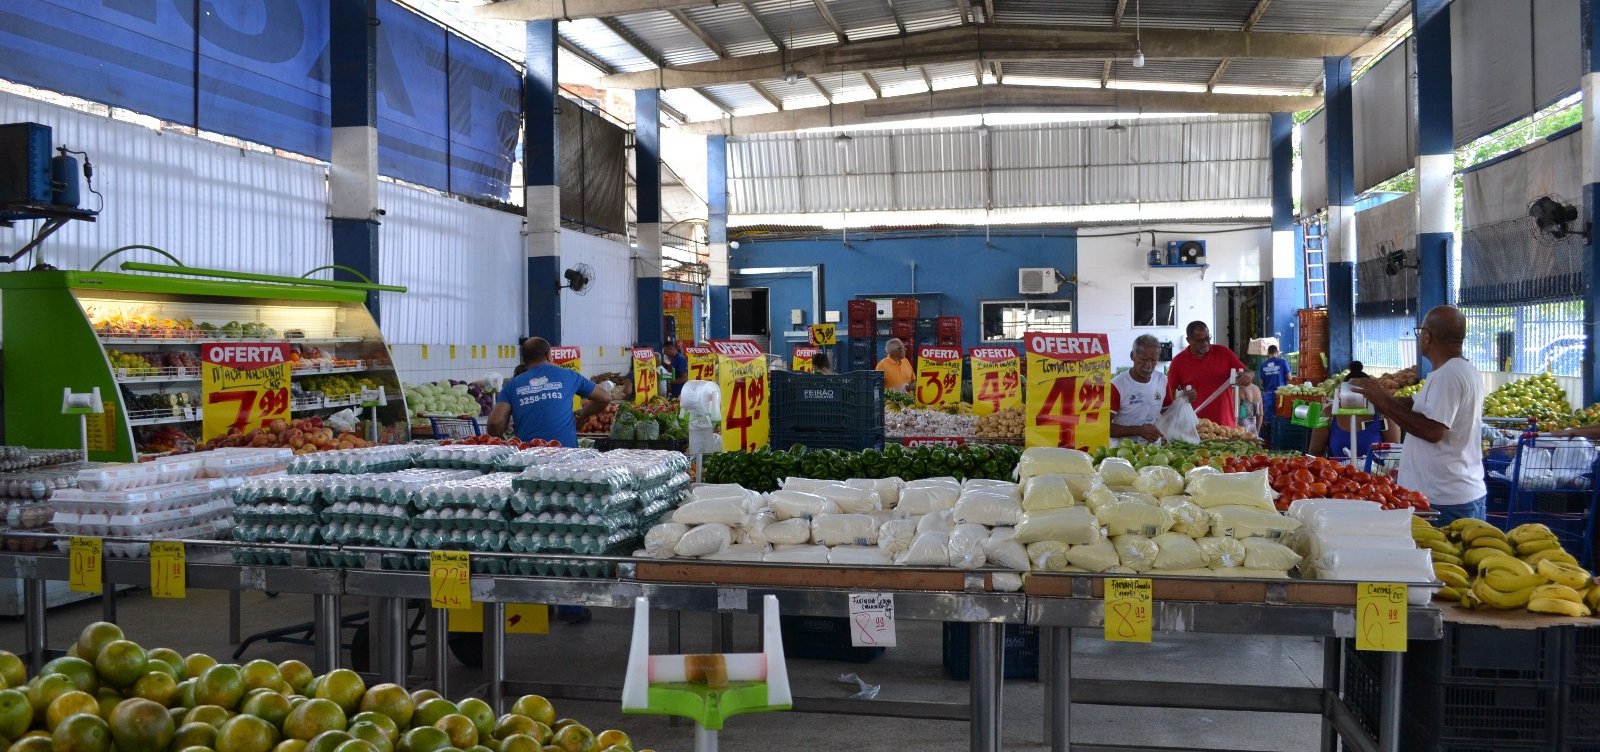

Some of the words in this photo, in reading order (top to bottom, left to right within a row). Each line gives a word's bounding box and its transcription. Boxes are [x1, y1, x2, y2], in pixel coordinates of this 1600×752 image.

[715, 341, 762, 355] OFERTA
[1031, 336, 1104, 354] OFERTA
[209, 346, 284, 363] OFERTA
[550, 349, 578, 360] FERTA
[633, 350, 654, 358] OFERTA
[922, 348, 960, 359] OFERTA
[973, 348, 1016, 358] OFERTA
[804, 388, 834, 396] FEIRÃO
